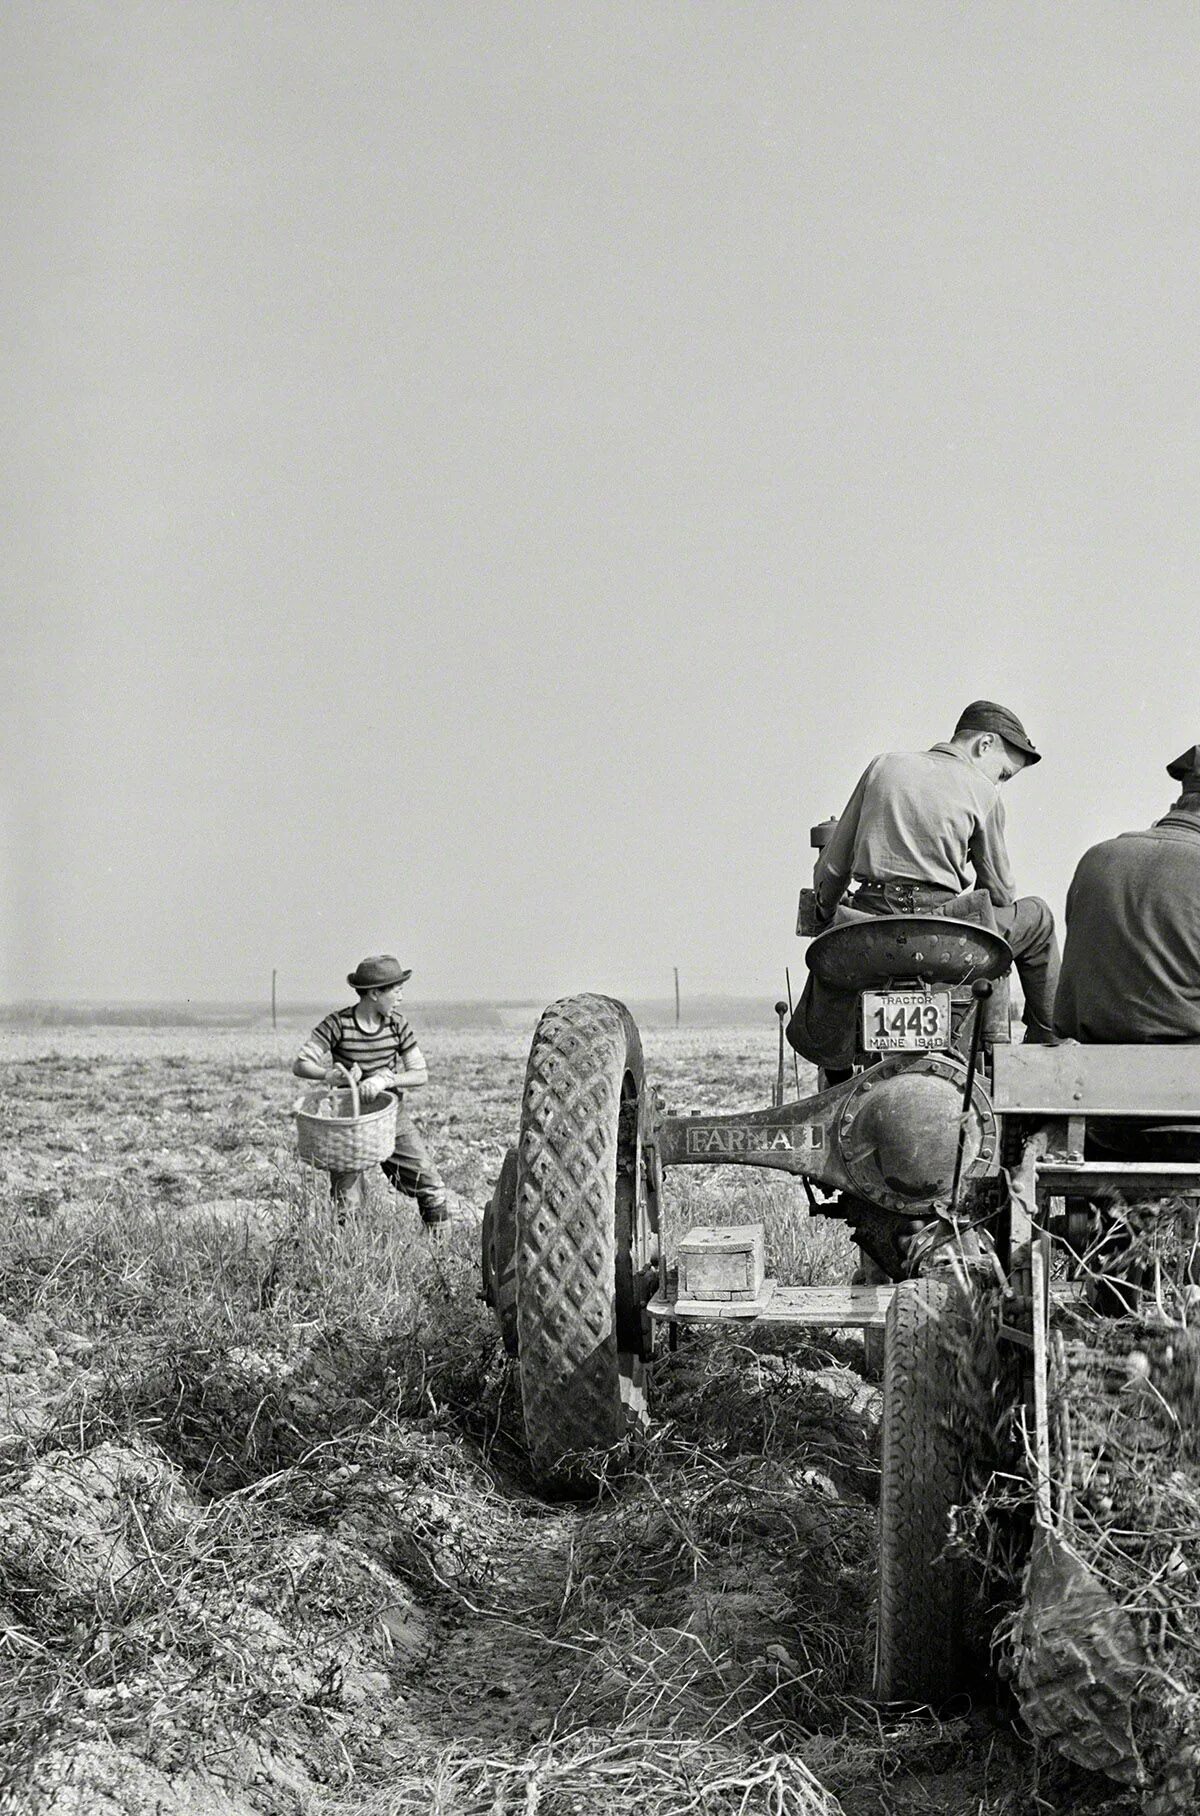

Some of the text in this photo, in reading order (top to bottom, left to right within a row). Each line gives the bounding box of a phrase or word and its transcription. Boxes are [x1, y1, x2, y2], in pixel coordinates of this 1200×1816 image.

[881, 997, 932, 1005] TRACTOR
[874, 1006, 939, 1037] 1443
[870, 1038, 943, 1048] MAINE 1940
[692, 1126, 822, 1152] FARMAL
